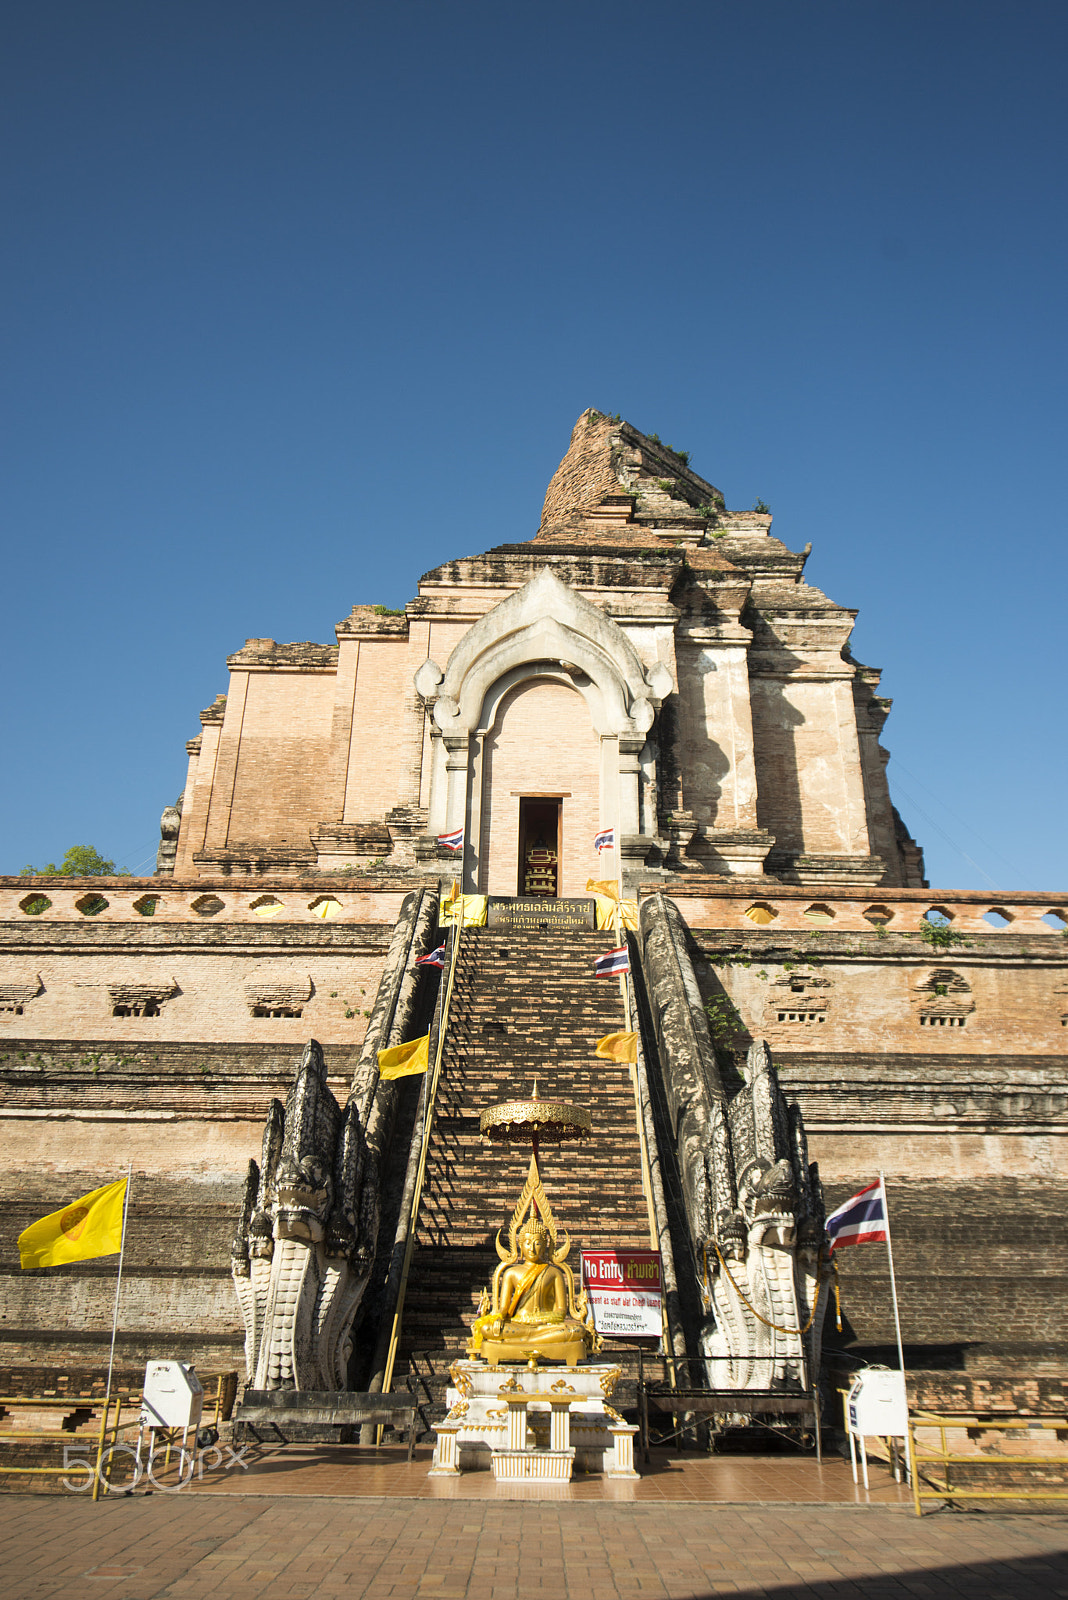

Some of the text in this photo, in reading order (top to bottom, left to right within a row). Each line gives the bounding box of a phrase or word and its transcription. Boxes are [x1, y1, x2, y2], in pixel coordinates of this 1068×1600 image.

[584, 1259, 660, 1283] No Entry ห้ามเข้า
[622, 1297, 631, 1307] Wat
[632, 1297, 645, 1307] Chedi
[646, 1297, 661, 1309] Luang
